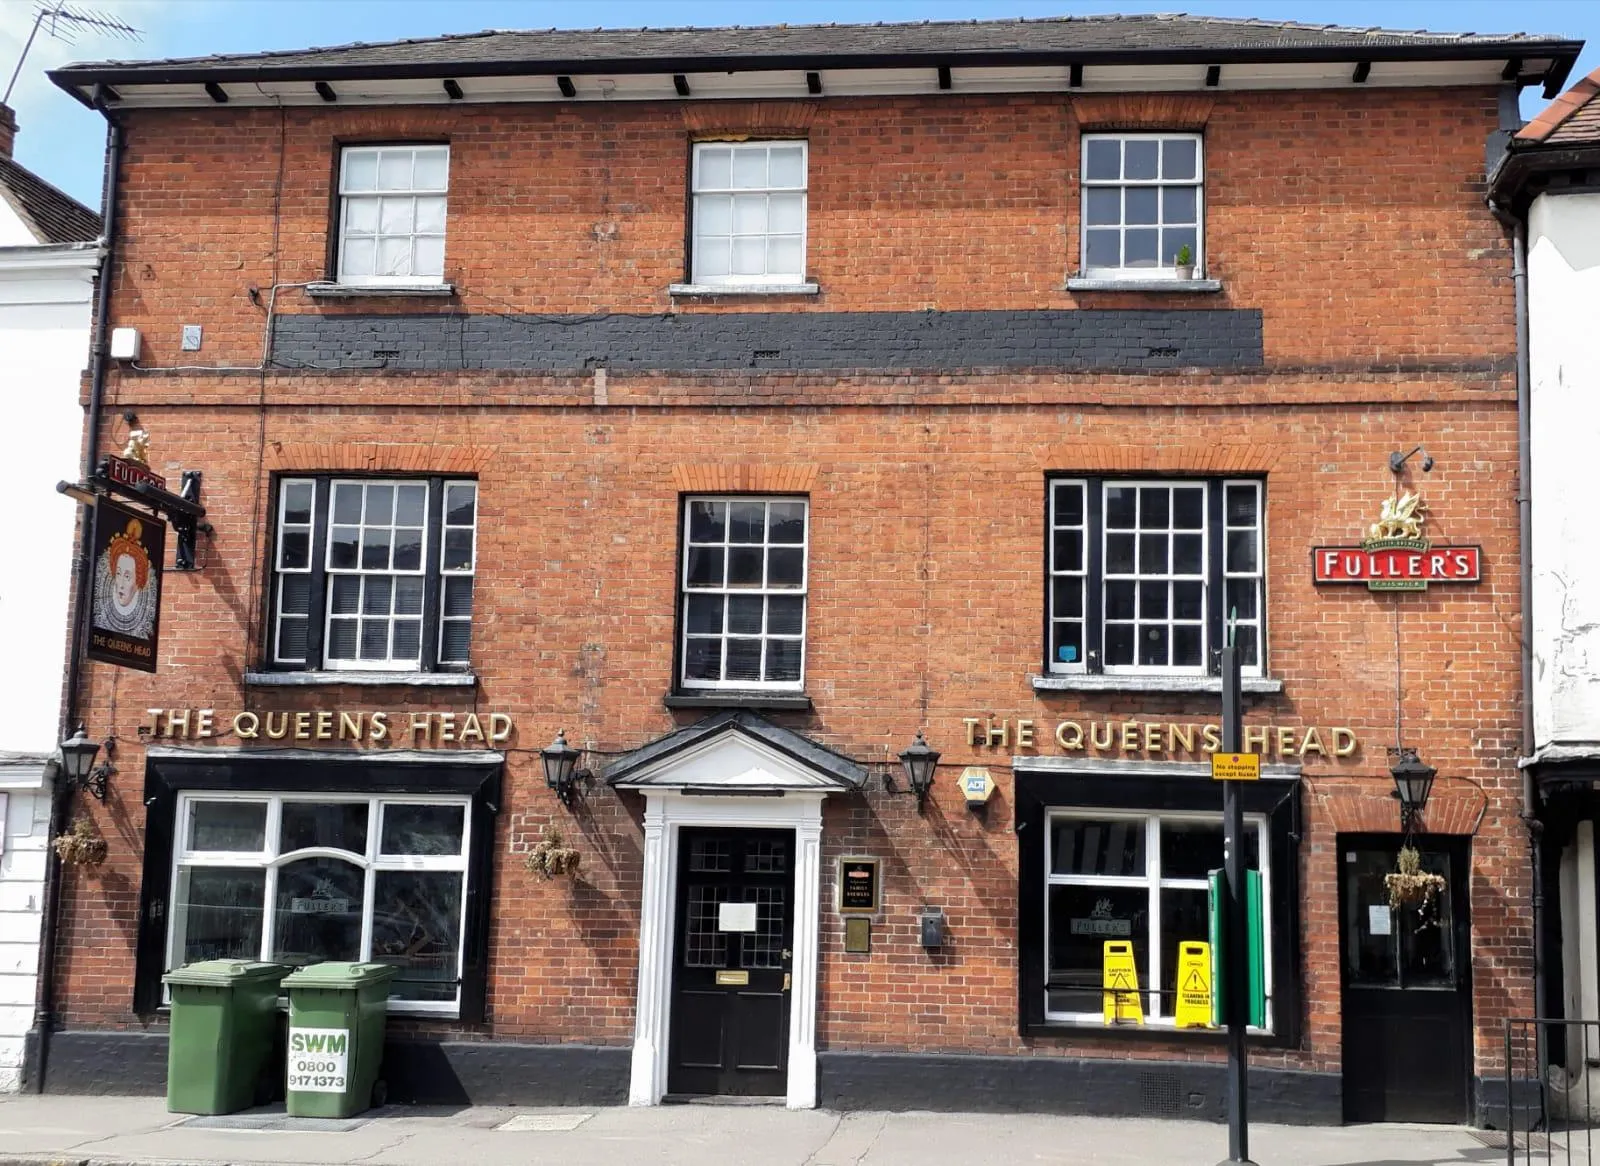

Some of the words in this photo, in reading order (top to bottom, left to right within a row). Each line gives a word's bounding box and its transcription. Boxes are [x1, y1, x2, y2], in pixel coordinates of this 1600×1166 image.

[1324, 551, 1469, 577] FULLER'S
[94, 634, 106, 648] THE
[107, 638, 132, 653] QUEENS
[134, 644, 151, 657] HEAD
[147, 708, 214, 738] THE
[232, 711, 388, 740] QUEENS
[407, 712, 513, 741] HEAD
[962, 717, 1034, 747] THE
[1055, 721, 1222, 753] QUEENS
[1244, 725, 1357, 757] HEAD
[968, 780, 985, 789] ADT
[291, 1033, 346, 1053] SWM
[297, 1061, 336, 1072] 0800
